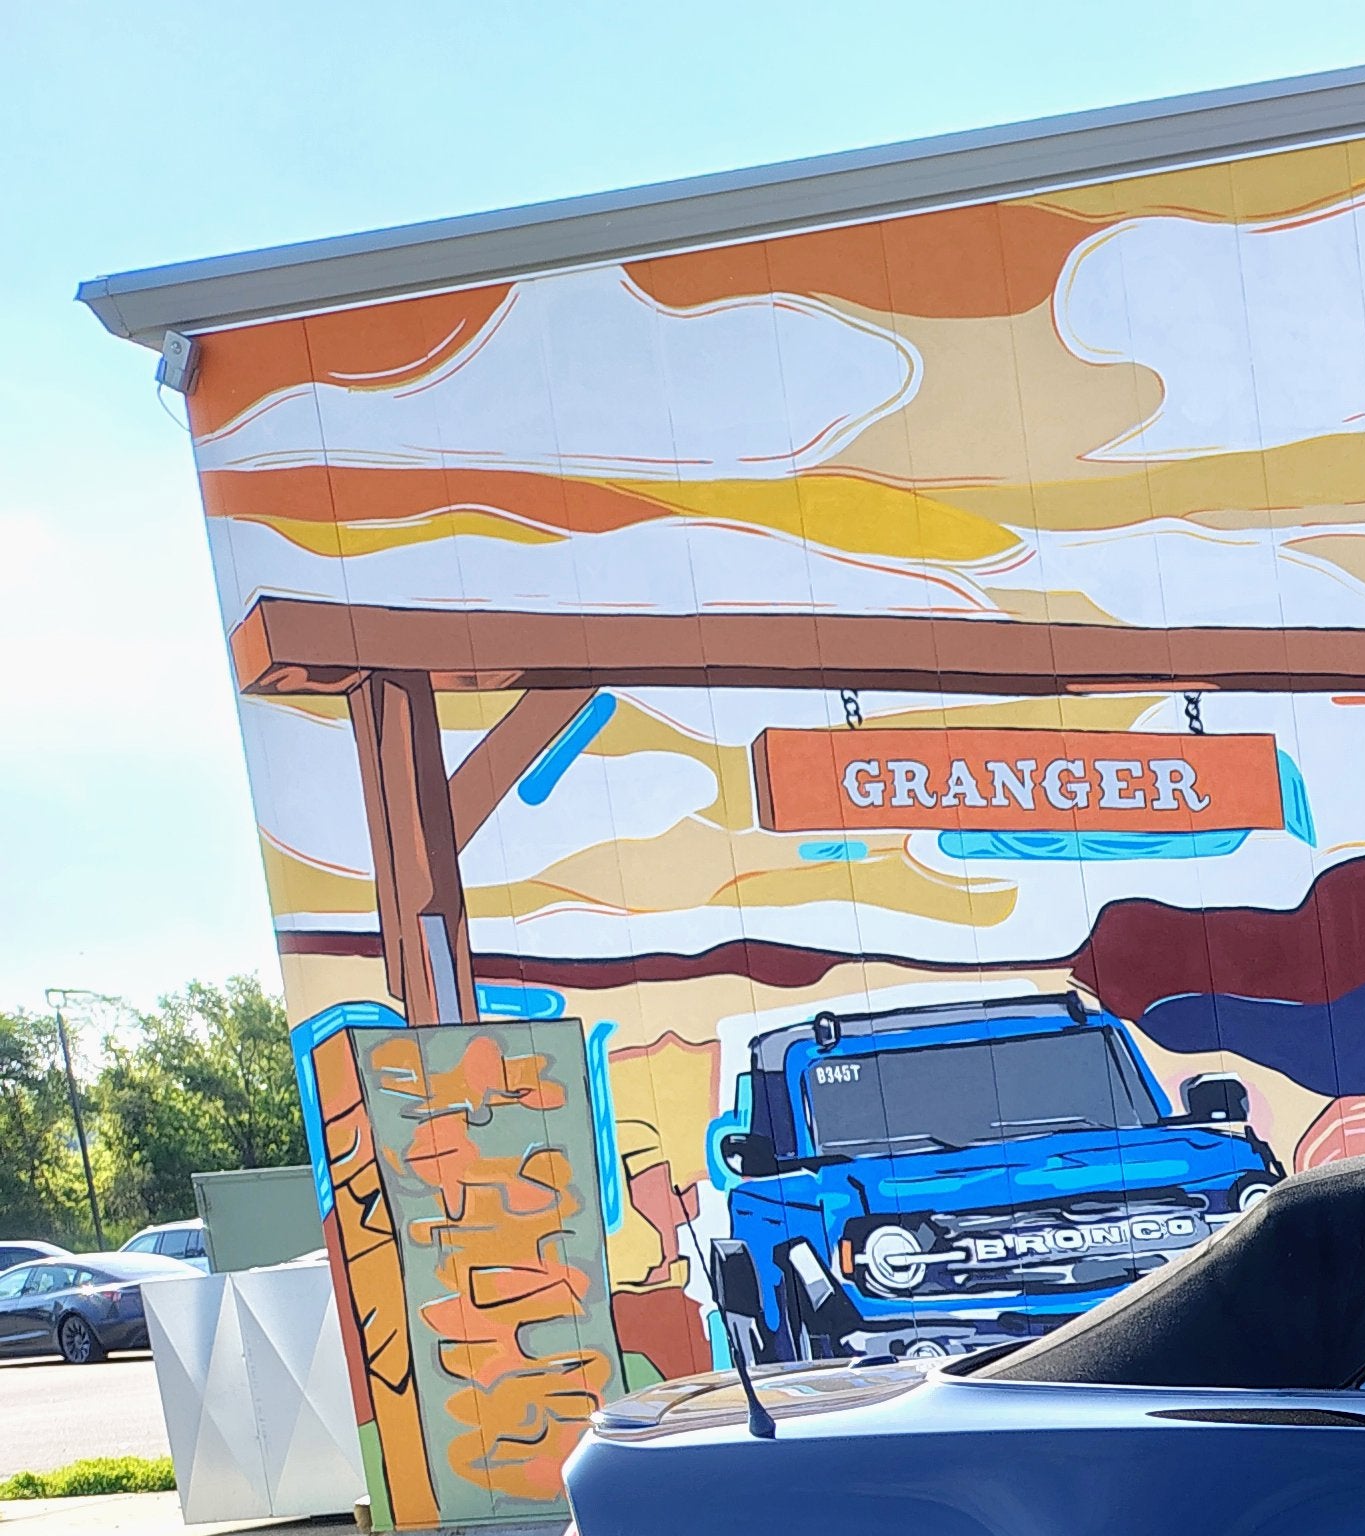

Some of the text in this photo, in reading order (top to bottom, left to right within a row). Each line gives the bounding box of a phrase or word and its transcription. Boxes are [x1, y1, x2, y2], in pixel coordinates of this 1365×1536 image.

[842, 758, 1211, 813] GRANGER
[815, 1063, 861, 1084] B345T
[974, 1216, 1195, 1261] BRONCO
